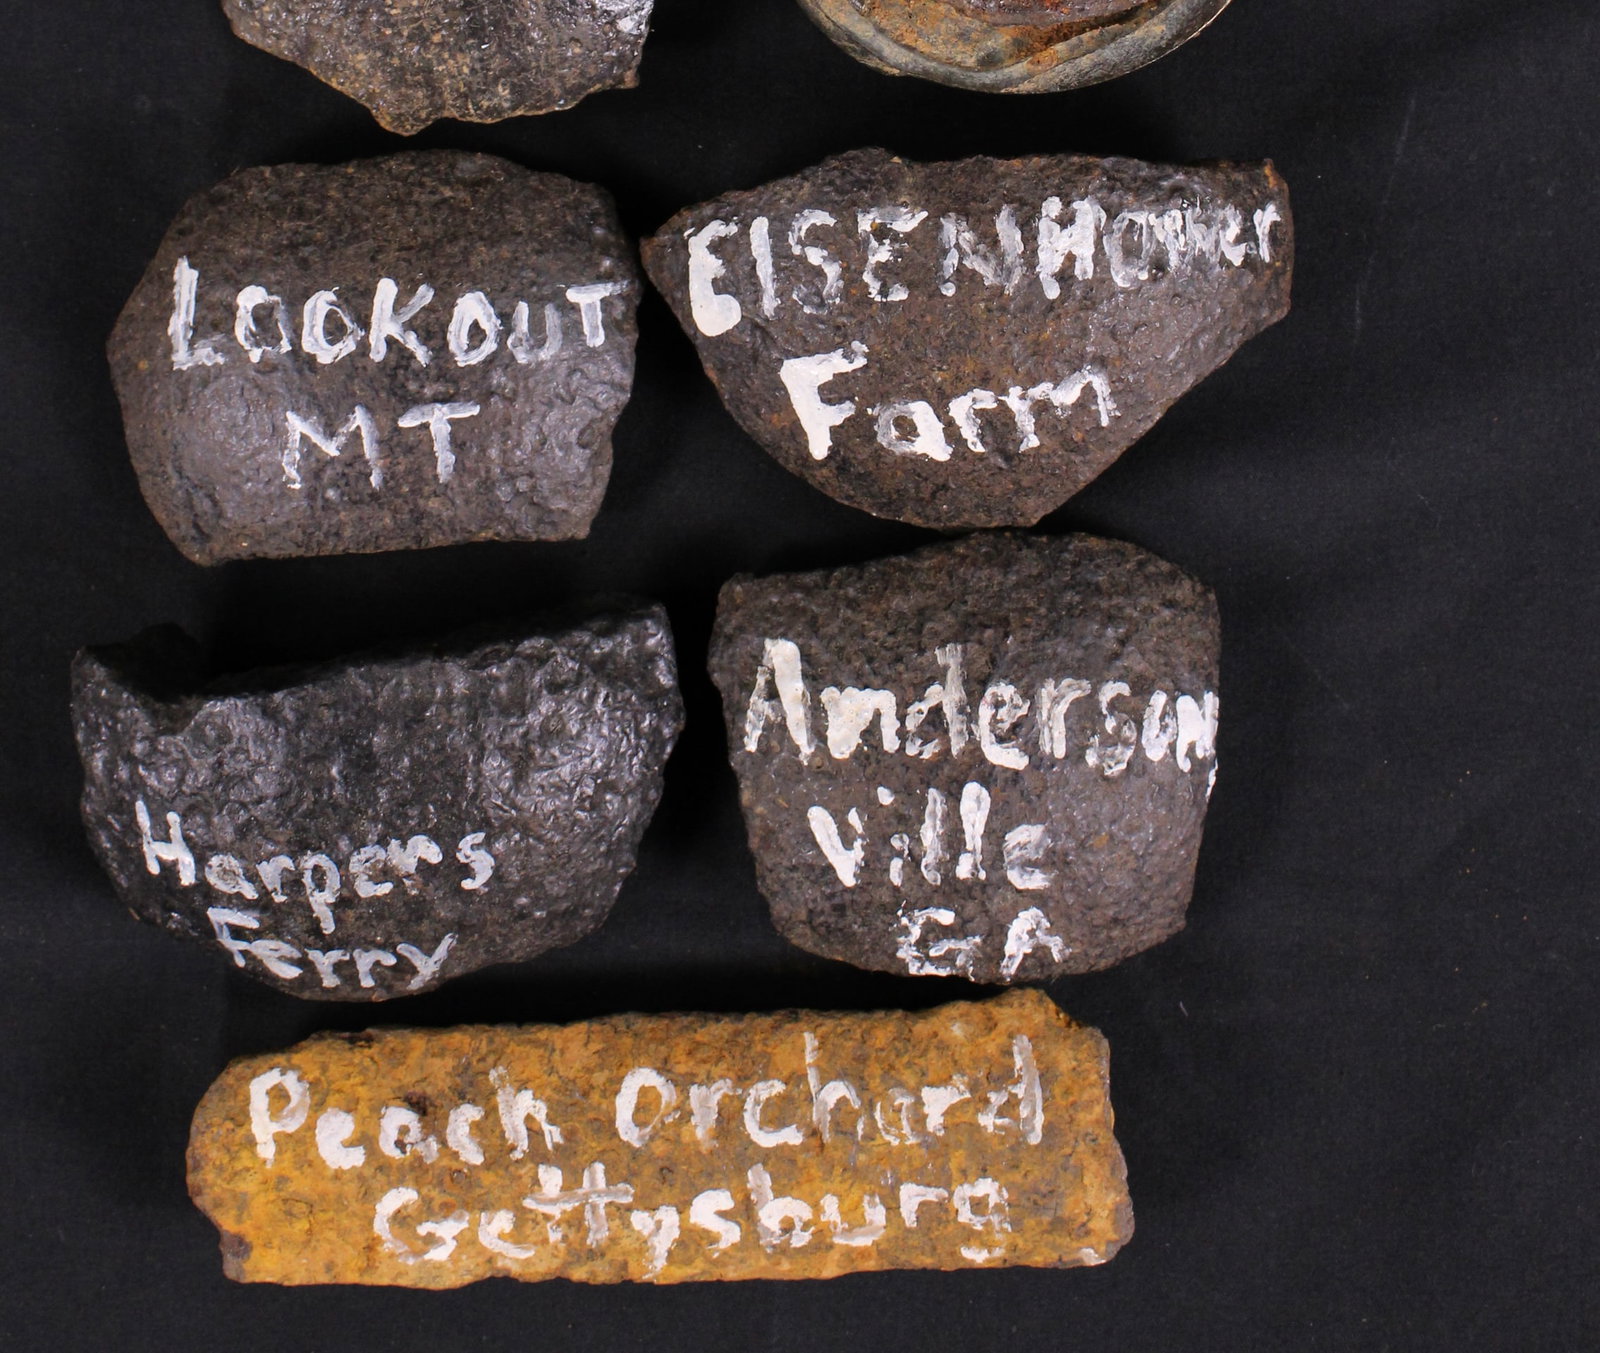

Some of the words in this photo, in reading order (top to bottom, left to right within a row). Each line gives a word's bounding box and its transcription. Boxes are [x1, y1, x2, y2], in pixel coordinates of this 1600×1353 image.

[281, 401, 482, 491] MT
[779, 341, 1120, 461] Farm
[135, 800, 496, 935] Harpers
[206, 906, 460, 991] Ferry
[248, 1065, 563, 1169] Peach
[614, 1030, 1044, 1149] Orchard
[373, 1161, 1010, 1280] Gettysburg
